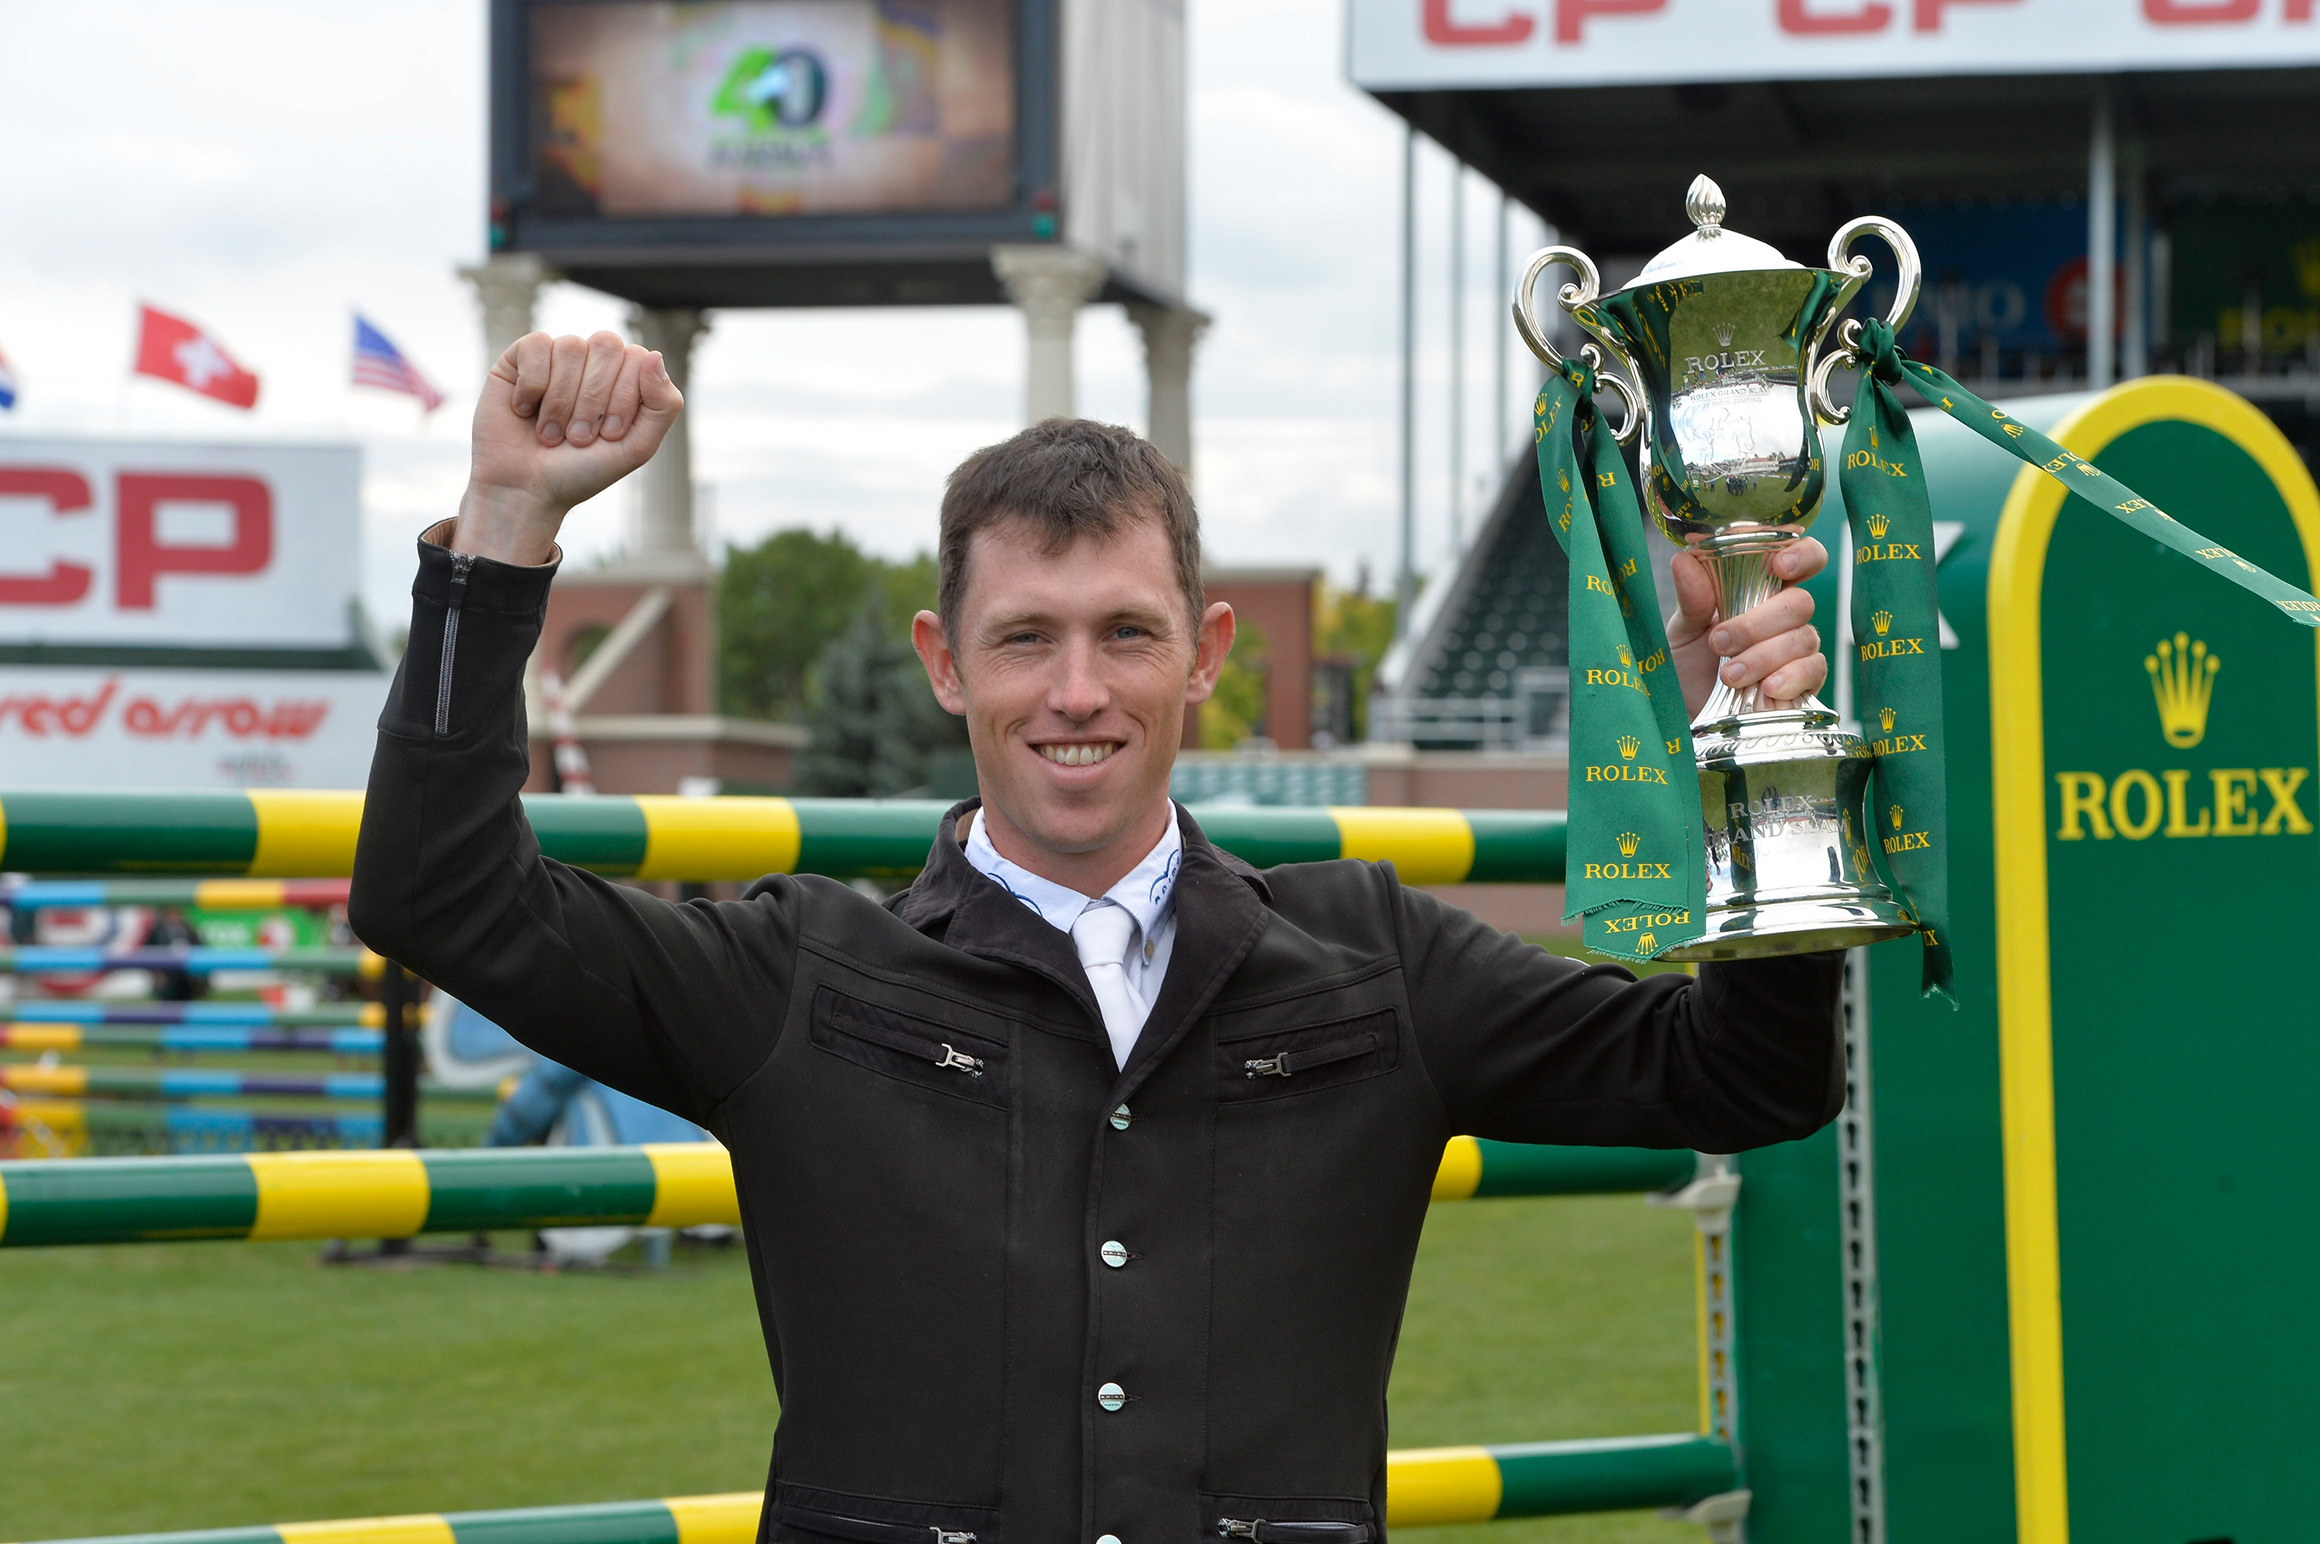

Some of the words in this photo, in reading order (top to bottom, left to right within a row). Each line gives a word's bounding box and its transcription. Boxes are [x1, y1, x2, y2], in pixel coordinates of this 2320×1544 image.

[1685, 350, 1766, 374] ROLEX
[1690, 390, 1716, 401] ROLEX
[1718, 388, 1747, 397] GRAND
[1847, 450, 1907, 477] ROLEX
[1856, 543, 1921, 565] ROLEX
[1861, 638, 1924, 662] ROLEX
[1872, 734, 1927, 758] ROLEX
[1585, 765, 1668, 785] ROLEX
[1728, 795, 1814, 819] ROLEX
[2055, 768, 2313, 840] ROLEX
[1883, 831, 1930, 854] ROLEX
[1584, 863, 1672, 879] ROLEX
[1604, 911, 1690, 934] ROLEX
